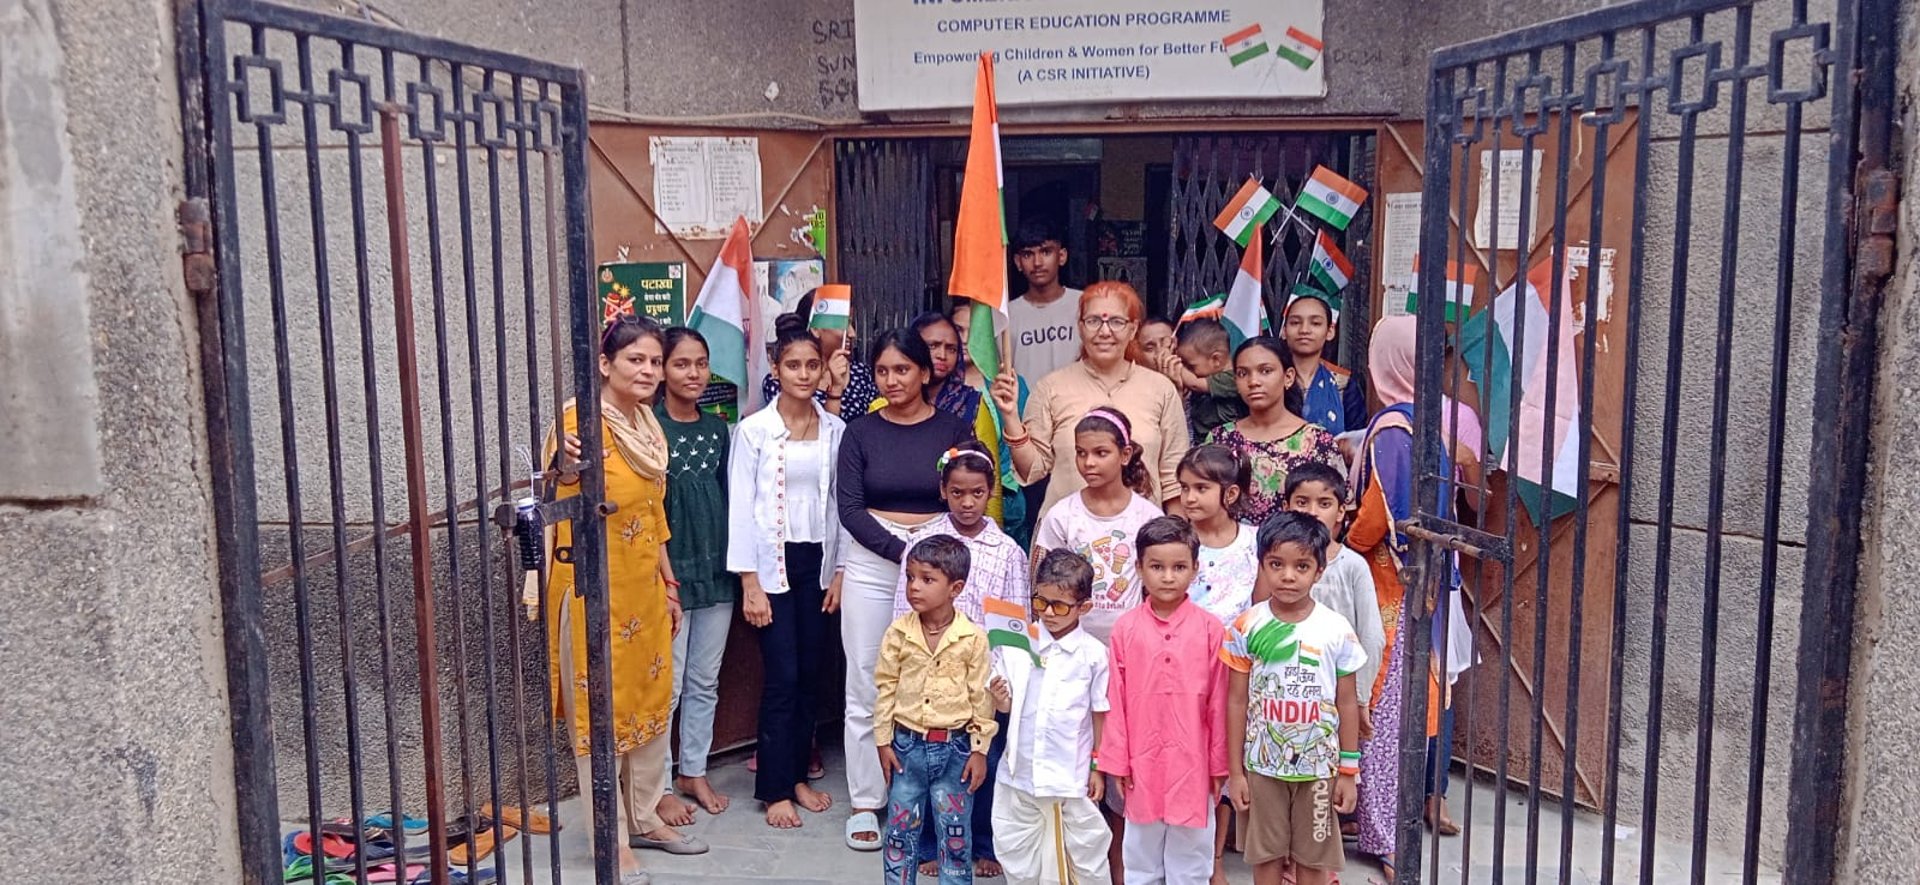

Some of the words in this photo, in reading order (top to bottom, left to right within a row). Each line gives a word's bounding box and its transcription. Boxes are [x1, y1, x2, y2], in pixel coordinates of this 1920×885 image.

[937, 17, 1025, 33] COMPUTER
[1030, 13, 1121, 29] EDUCATION
[1126, 9, 1231, 27] PROGRAMME
[914, 50, 1000, 66] Empowerig
[1005, 47, 1062, 61] Children
[1068, 46, 1078, 58] &
[1082, 44, 1134, 58] Women
[1139, 44, 1158, 56] for
[1163, 42, 1205, 55] Better
[1018, 70, 1032, 84] (A
[1036, 68, 1067, 81] CSR
[1072, 65, 1150, 80] INITIATIVE)
[1021, 325, 1073, 346] GUCCI
[1263, 698, 1320, 724] INDIA
[1311, 780, 1329, 842] QUADRO
